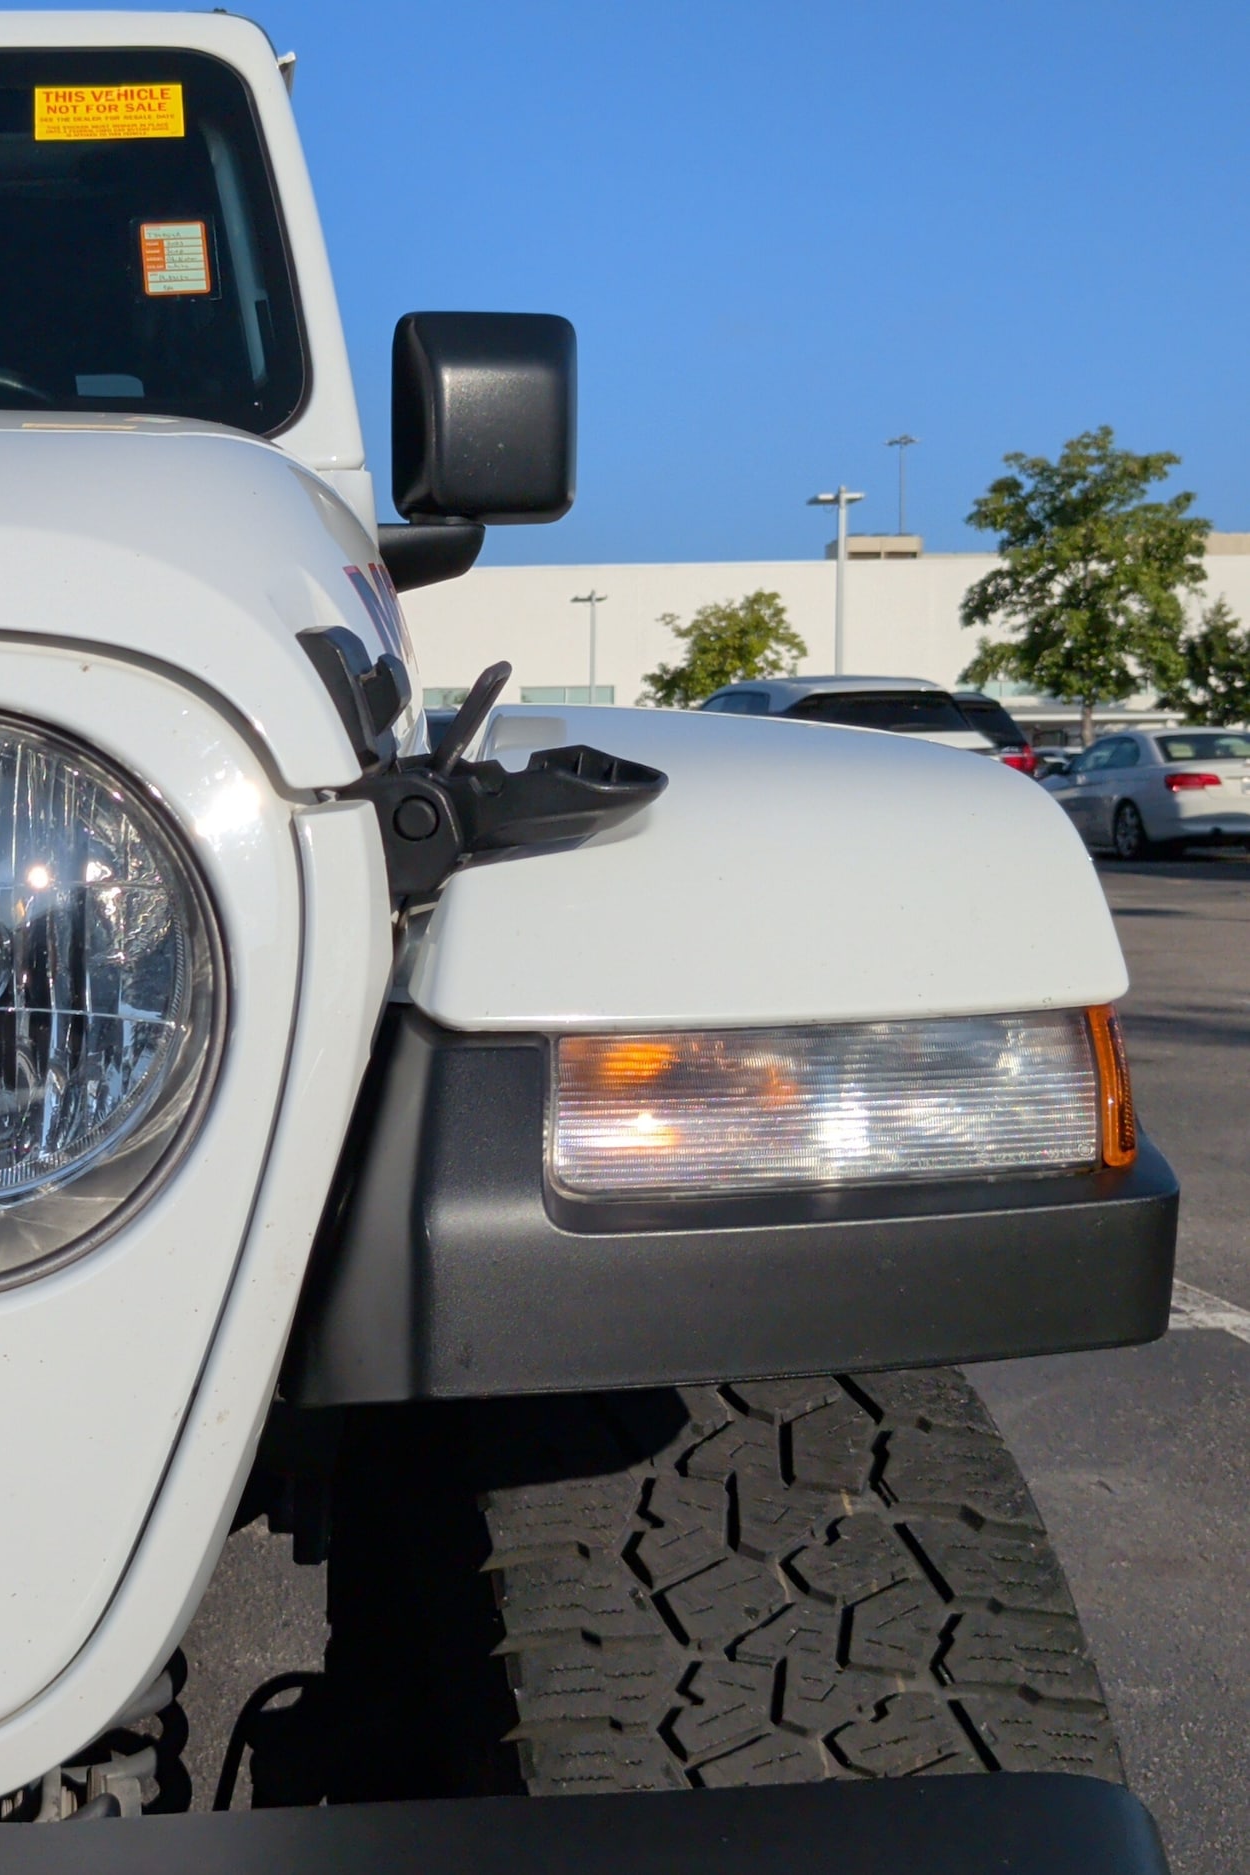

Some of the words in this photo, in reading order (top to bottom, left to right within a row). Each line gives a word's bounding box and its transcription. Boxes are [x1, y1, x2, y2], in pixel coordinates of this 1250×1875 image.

[42, 91, 85, 103] THIS
[91, 88, 171, 102] VEHICLE
[46, 105, 79, 114] NOT
[85, 103, 118, 113] FOR
[125, 102, 167, 112] SALE
